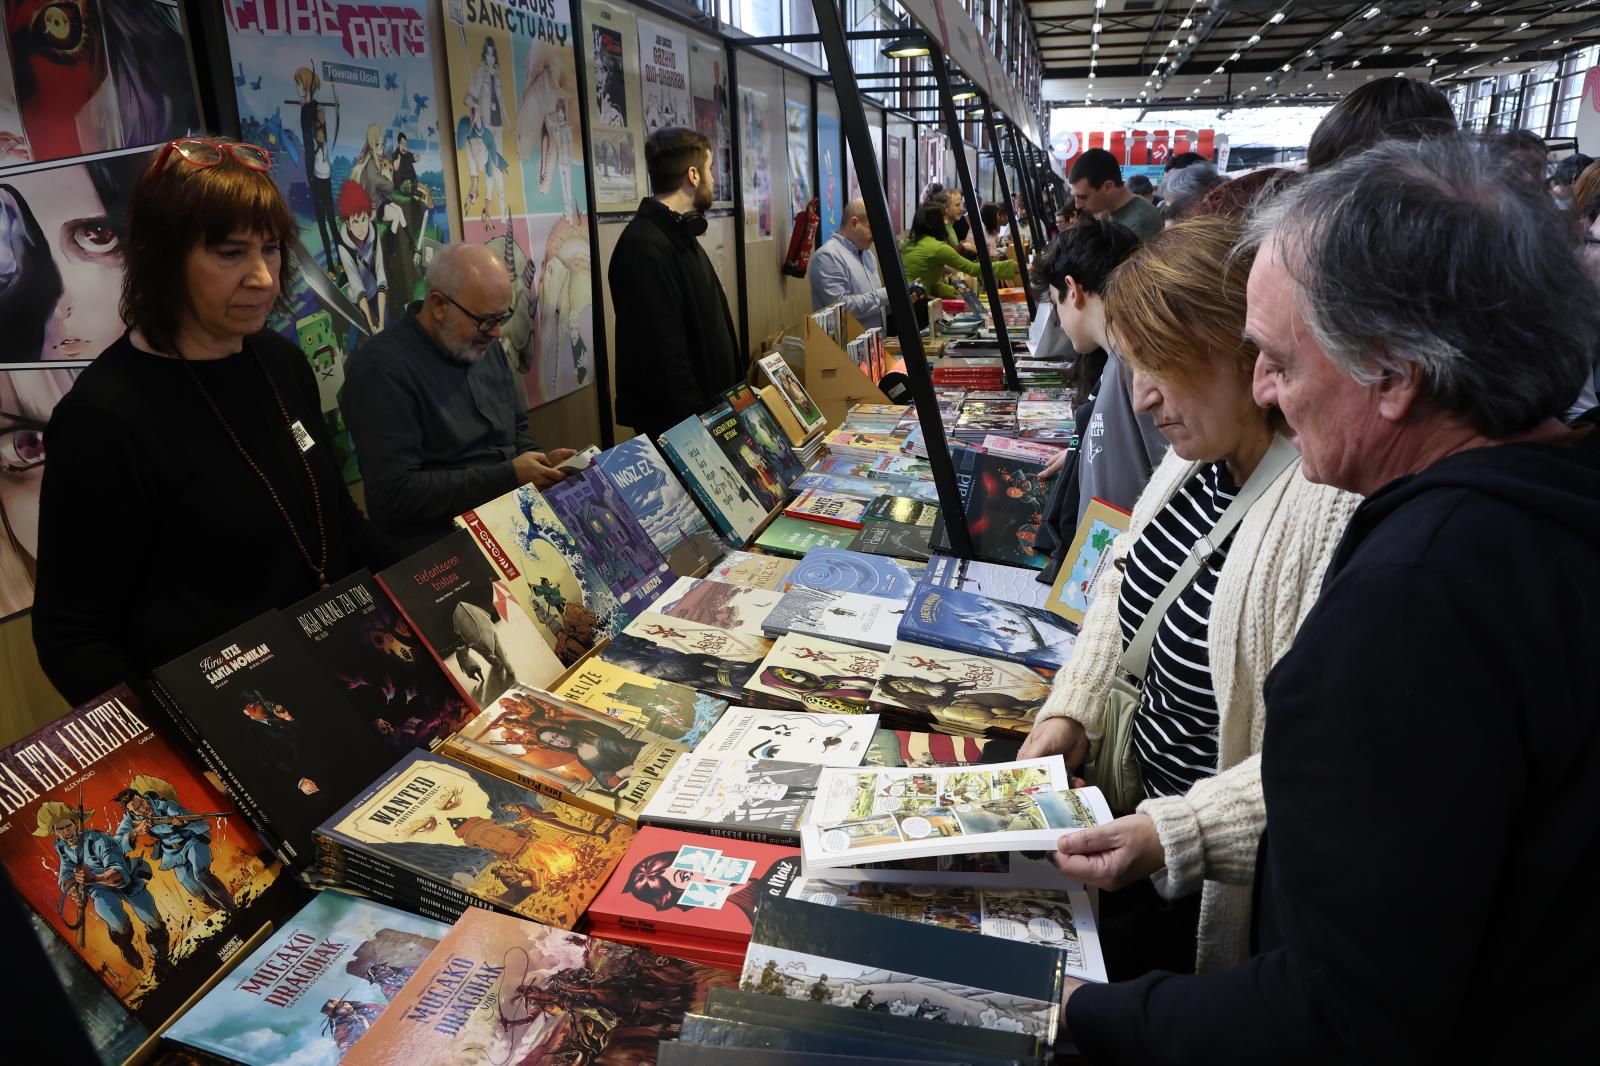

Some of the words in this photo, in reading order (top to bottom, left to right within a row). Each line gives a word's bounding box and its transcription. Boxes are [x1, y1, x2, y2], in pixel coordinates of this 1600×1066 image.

[337, 4, 425, 59] ARTS
[466, 0, 567, 47] SANCTUARY
[610, 465, 642, 489] INOIZ
[636, 459, 654, 476] EZ
[414, 556, 460, 585] Elefantearen
[431, 573, 459, 591] tristura
[200, 656, 224, 673] Hiru
[221, 644, 241, 660] ETXE
[206, 664, 234, 684] SANTA
[229, 643, 270, 671] MONIKAN
[15, 740, 78, 792] ETA
[56, 697, 149, 770] AHAZTEA
[202, 739, 228, 771] MONIKAN
[642, 748, 677, 778] PLANA
[64, 779, 78, 792] ALEX
[75, 770, 96, 786] MACHO
[228, 771, 245, 792] SANTA
[517, 774, 542, 790] PLANA
[368, 776, 436, 825] WANTED
[465, 895, 494, 912] WANTED
[240, 933, 316, 996] MUGAKO
[264, 937, 346, 1008] DRAGOIAK
[407, 958, 474, 1024] MUGAKO
[434, 961, 506, 1036] DRAGOIAK
